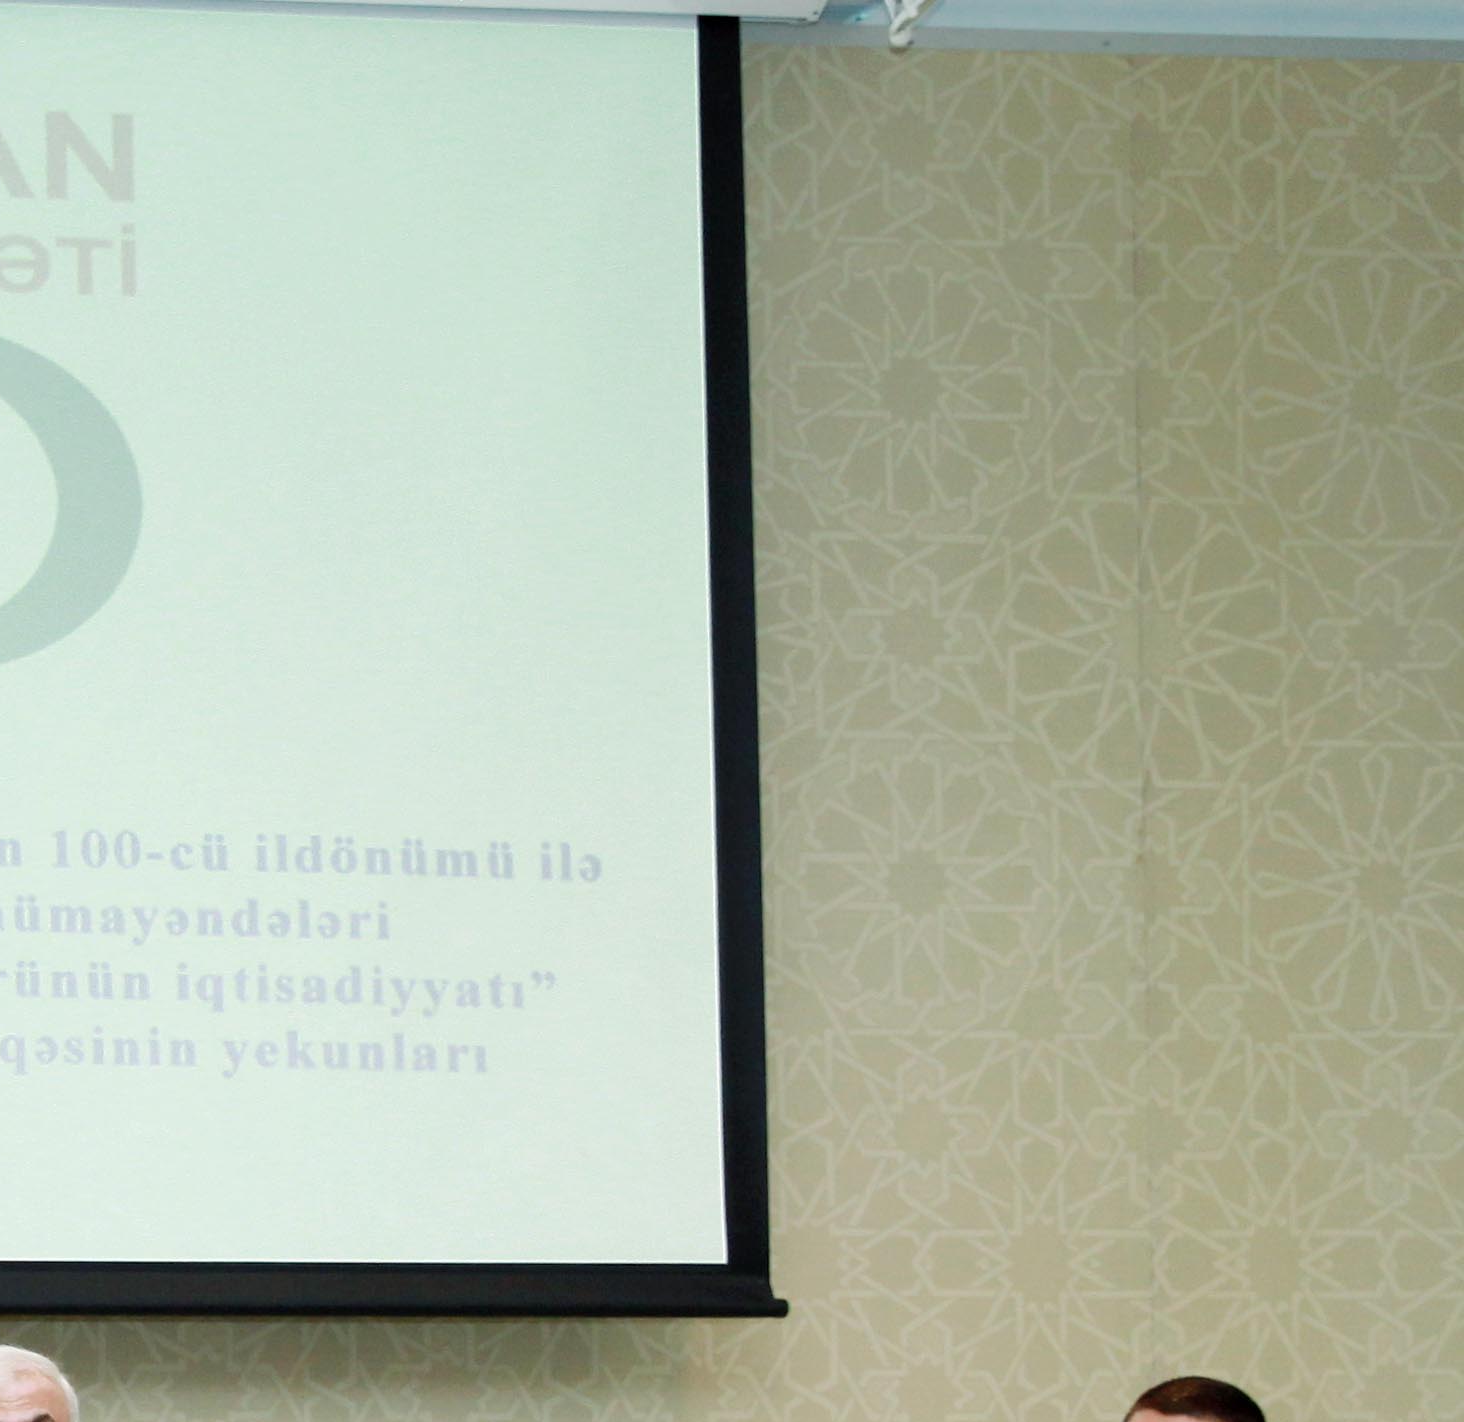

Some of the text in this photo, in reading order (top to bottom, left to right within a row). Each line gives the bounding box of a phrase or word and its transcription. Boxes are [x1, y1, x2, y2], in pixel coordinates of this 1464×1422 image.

[52, 828, 229, 873] 100-cü
[255, 833, 515, 882] ildönümü
[539, 840, 603, 884] ilə
[222, 1029, 488, 1079] yekunları
